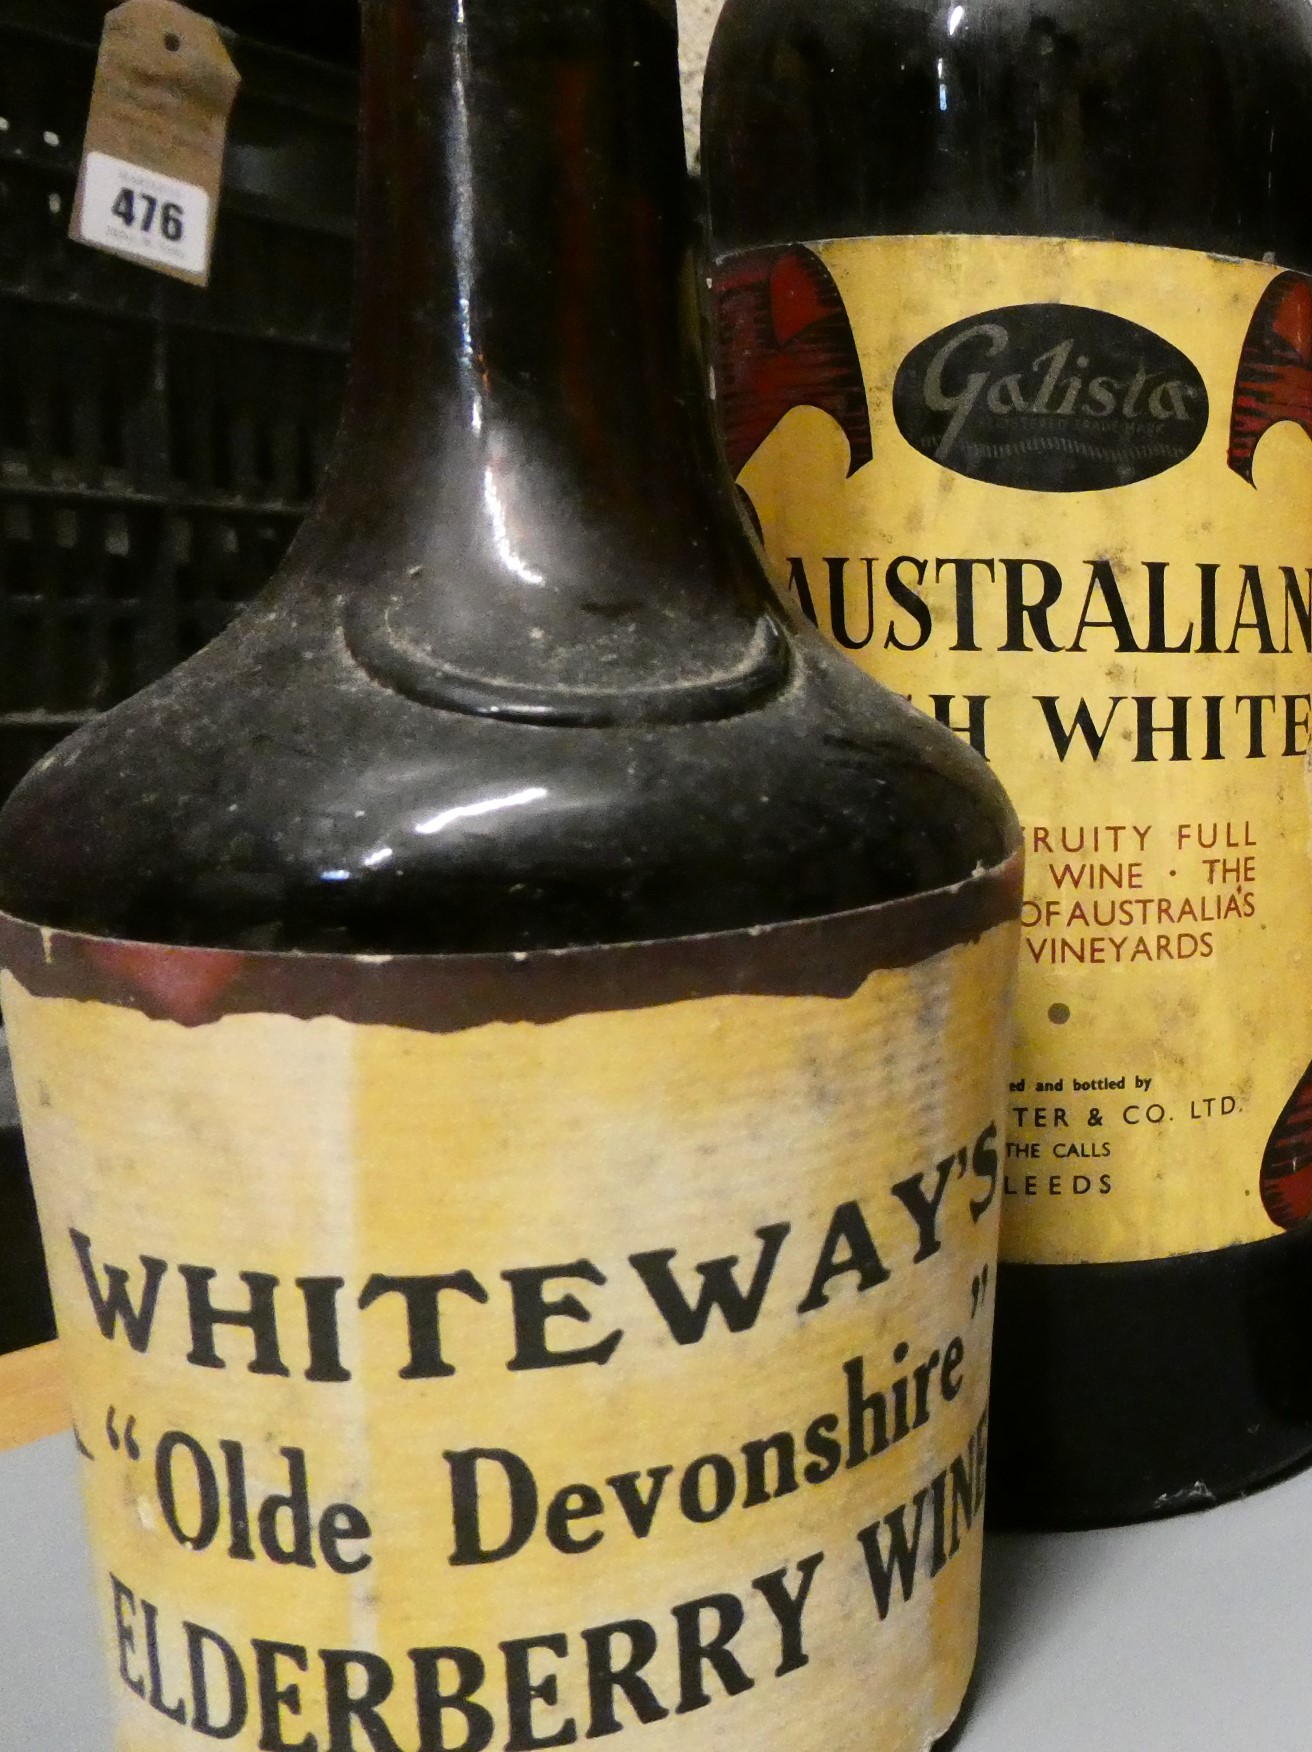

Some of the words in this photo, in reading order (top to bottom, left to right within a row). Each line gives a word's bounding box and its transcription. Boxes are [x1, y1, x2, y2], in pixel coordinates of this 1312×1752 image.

[111, 186, 184, 242] 476
[923, 324, 1198, 459] Galista
[1033, 693, 1312, 763] WHITE
[1020, 825, 1152, 853] RUITY
[1177, 821, 1256, 850] FULL
[1049, 863, 1143, 889] WINE
[1202, 856, 1256, 884] THE
[1020, 901, 1060, 927] OF
[1026, 932, 1213, 964] VINEYARDS
[1009, 1079, 1025, 1092] ed
[1036, 1079, 1063, 1092] and
[1073, 1076, 1125, 1092] bottled
[1135, 1075, 1152, 1092] by
[1012, 1107, 1069, 1128] TER
[1087, 1107, 1103, 1127] &
[1123, 1104, 1174, 1125] CO.
[1191, 1096, 1243, 1120] LTD.
[1006, 1142, 1041, 1159] THE
[1053, 1142, 1111, 1159] CALLS
[1004, 1174, 1111, 1196] LEEDS
[67, 1120, 999, 1383] WHITEWAY'S
[109, 1552, 823, 1752] ELDERBERRY
